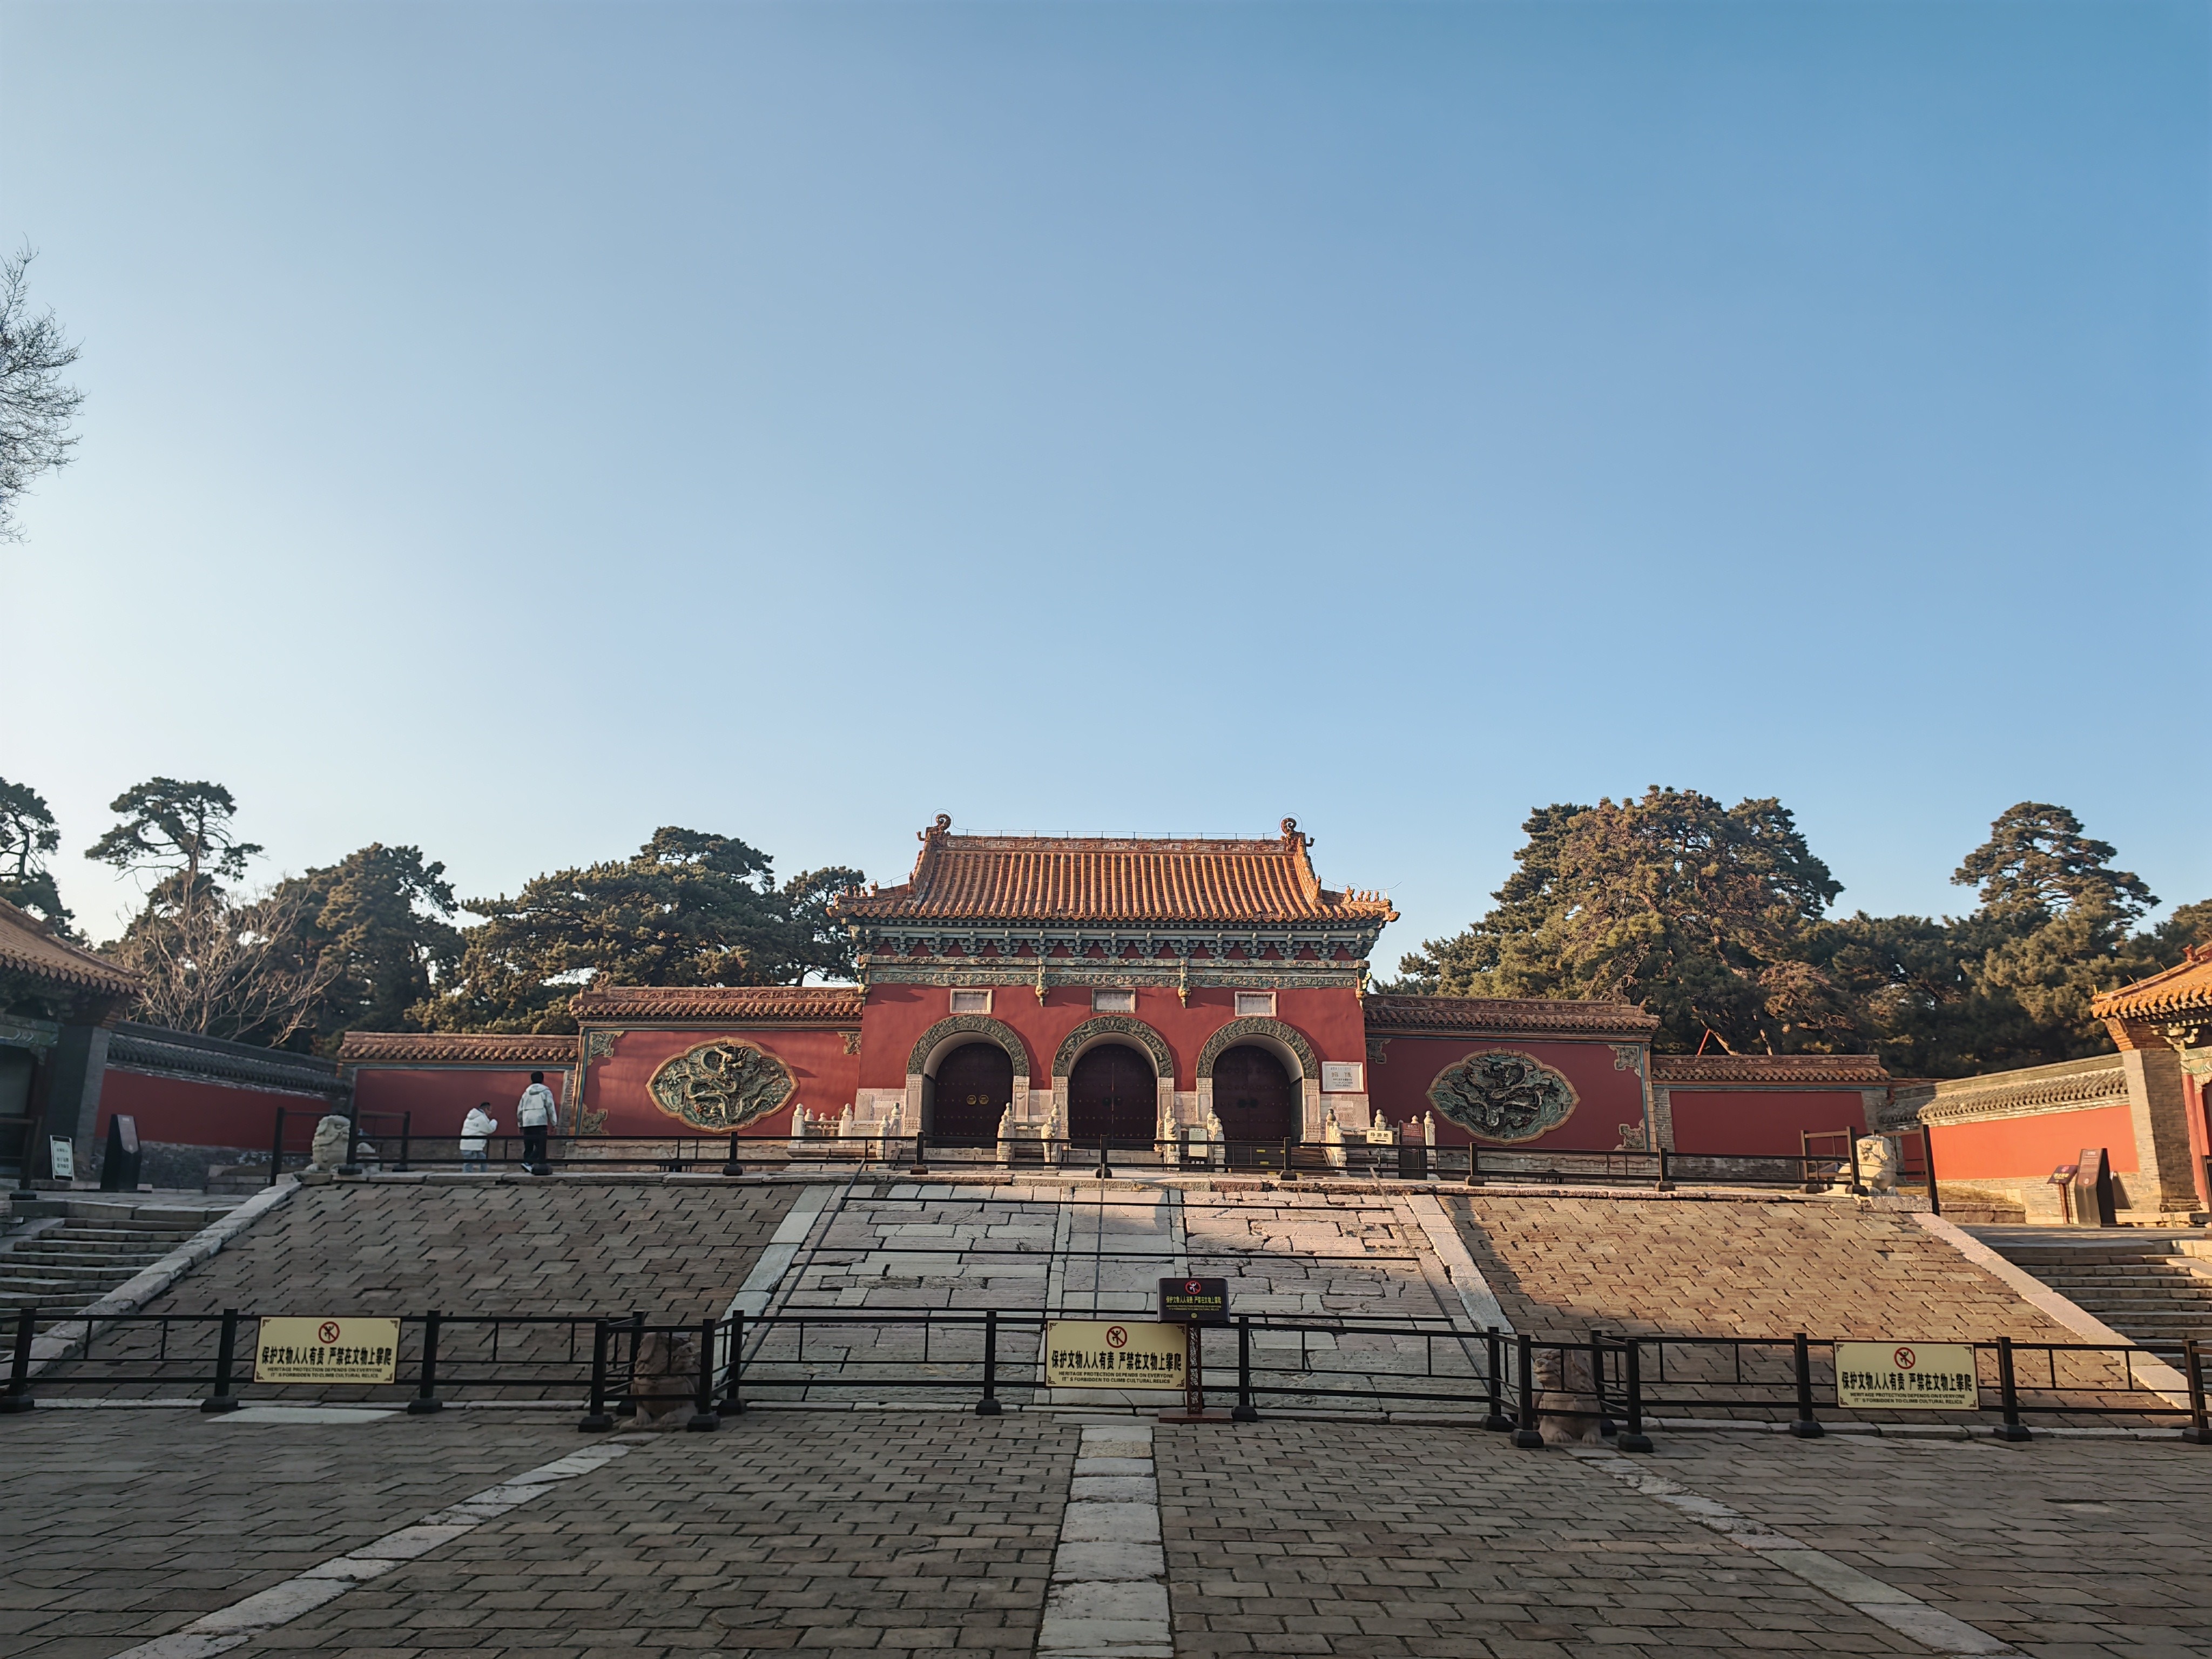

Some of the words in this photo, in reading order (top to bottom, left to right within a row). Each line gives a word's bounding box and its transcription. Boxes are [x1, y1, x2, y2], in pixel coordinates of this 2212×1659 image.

[262, 1346, 325, 1365] 保护文物人人有责
[327, 1346, 392, 1366] 严禁在文物上攀爬
[1051, 1350, 1114, 1370] 保护文物人人有责
[1118, 1351, 1181, 1371] 严禁在文物上攀爬
[1842, 1371, 1905, 1391] 保护文物人人有责
[1908, 1373, 1972, 1392] 严禁在文物上攀爬
